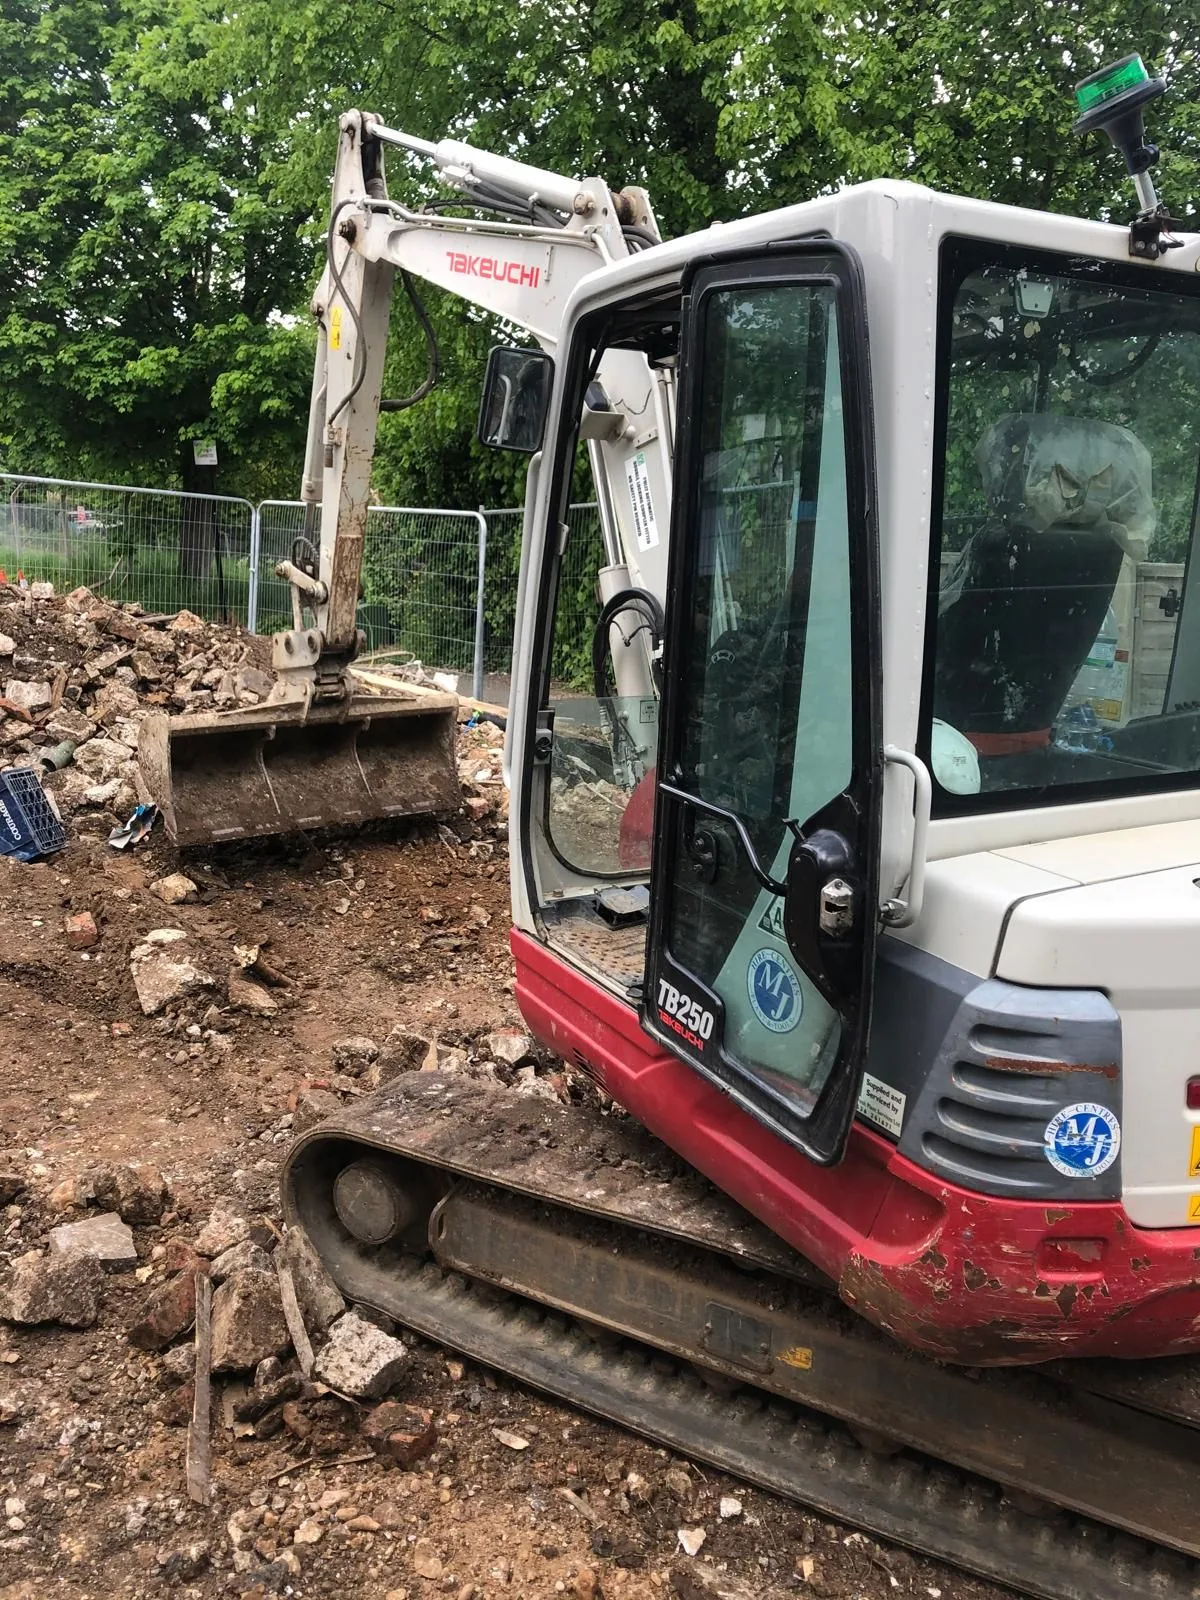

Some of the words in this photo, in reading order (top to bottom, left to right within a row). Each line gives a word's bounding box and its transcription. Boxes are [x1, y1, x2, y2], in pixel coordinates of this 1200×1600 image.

[658, 978, 714, 1040] TB250
[866, 1078, 890, 1098] Supplied
[890, 1094, 903, 1105] and
[866, 1089, 891, 1109] Serviced
[891, 1103, 899, 1115] by
[1047, 1110, 1068, 1136] HIRE
[1075, 1104, 1118, 1132] CENTRES
